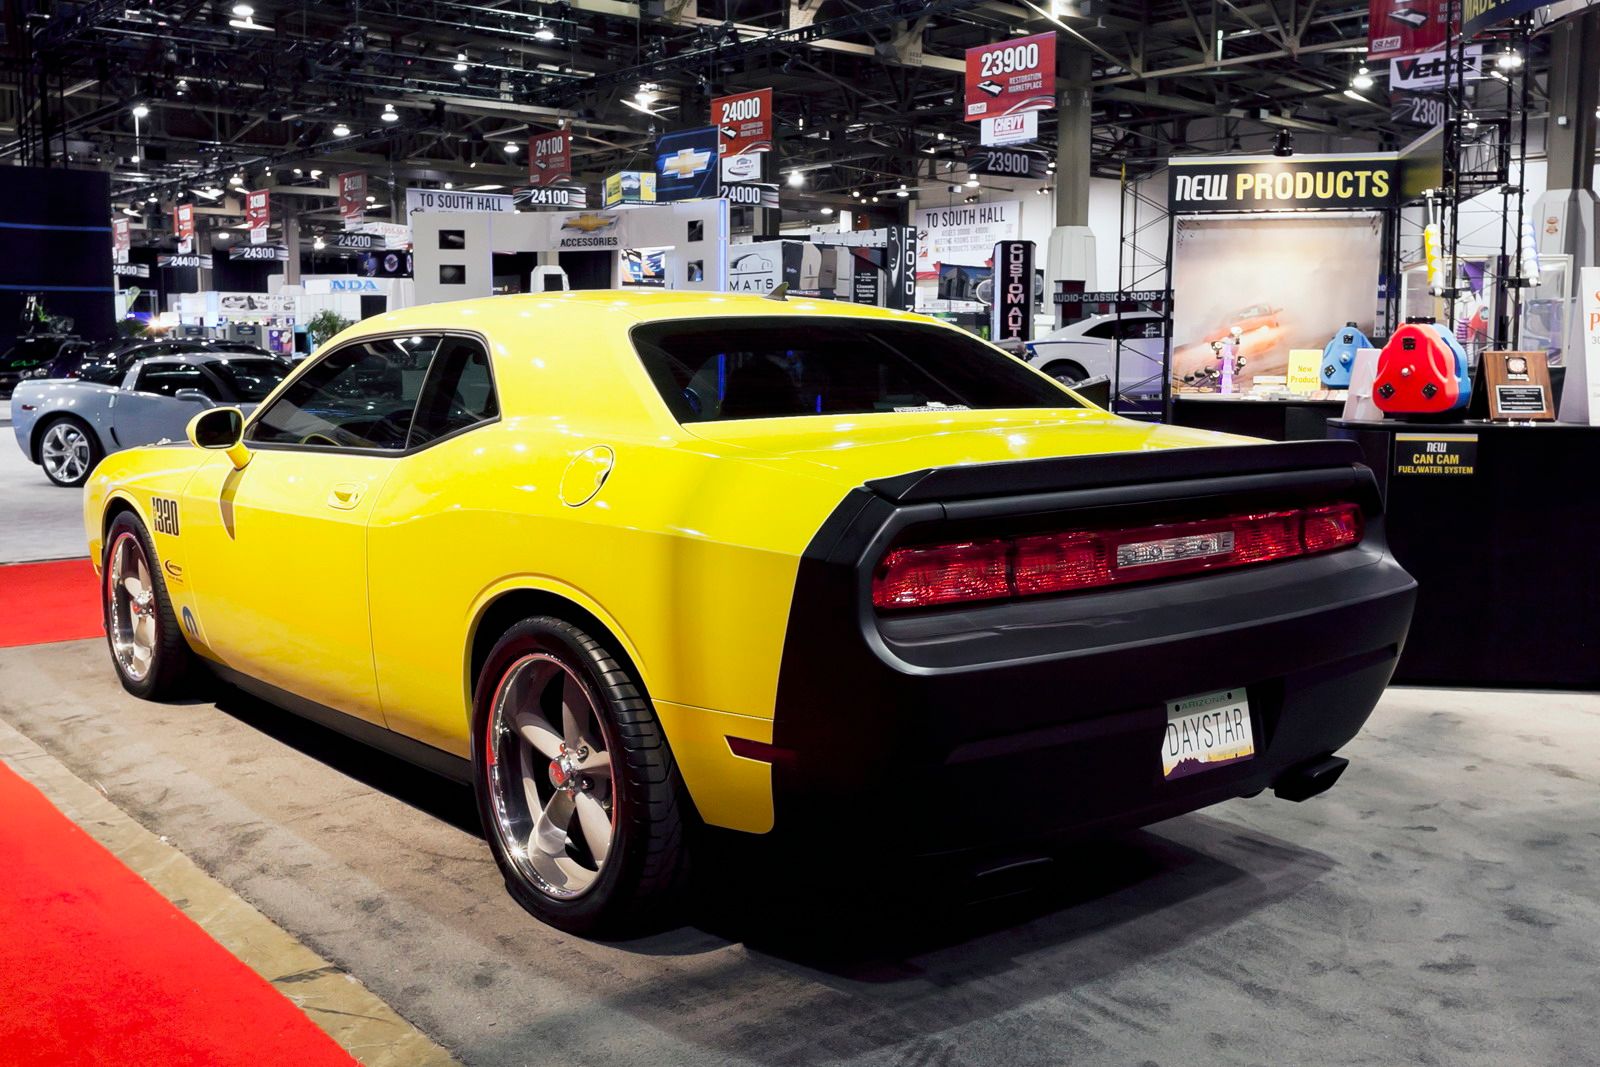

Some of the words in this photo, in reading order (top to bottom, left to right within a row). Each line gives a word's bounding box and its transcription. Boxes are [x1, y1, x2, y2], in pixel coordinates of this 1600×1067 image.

[981, 44, 1038, 77] 23900
[1008, 81, 1042, 93] MARKETPLACE
[1009, 73, 1042, 84] RESTORATION
[722, 97, 760, 123] 24000
[1412, 97, 1450, 126] 2380
[995, 116, 1023, 132] CHEVY
[536, 136, 563, 157] 24100
[987, 151, 1029, 174] 23900
[1236, 170, 1390, 200] PRODUCTS
[420, 193, 434, 207] TO
[437, 194, 474, 209] SOUTH
[477, 197, 504, 212] HALL
[531, 188, 569, 205] 24100
[720, 185, 760, 204] 24000
[926, 212, 938, 228] TO
[942, 208, 976, 227] SOUTH
[980, 206, 1006, 224] HALL
[338, 234, 371, 248] 24200
[560, 237, 618, 247] ACCESSORIES
[171, 256, 200, 267] 24400
[244, 247, 275, 259] 24300
[905, 227, 915, 296] LLOYD
[1007, 243, 1025, 304] CUSTOM
[729, 279, 774, 291] MATS
[1297, 365, 1313, 373] New
[1290, 376, 1319, 384] Product
[1412, 454, 1434, 465] CAN
[1436, 454, 1459, 465] CAM
[1398, 465, 1442, 474] FUEL/WATER
[1444, 466, 1474, 474] SYSTEM
[1167, 708, 1245, 757] DAYSTAR
